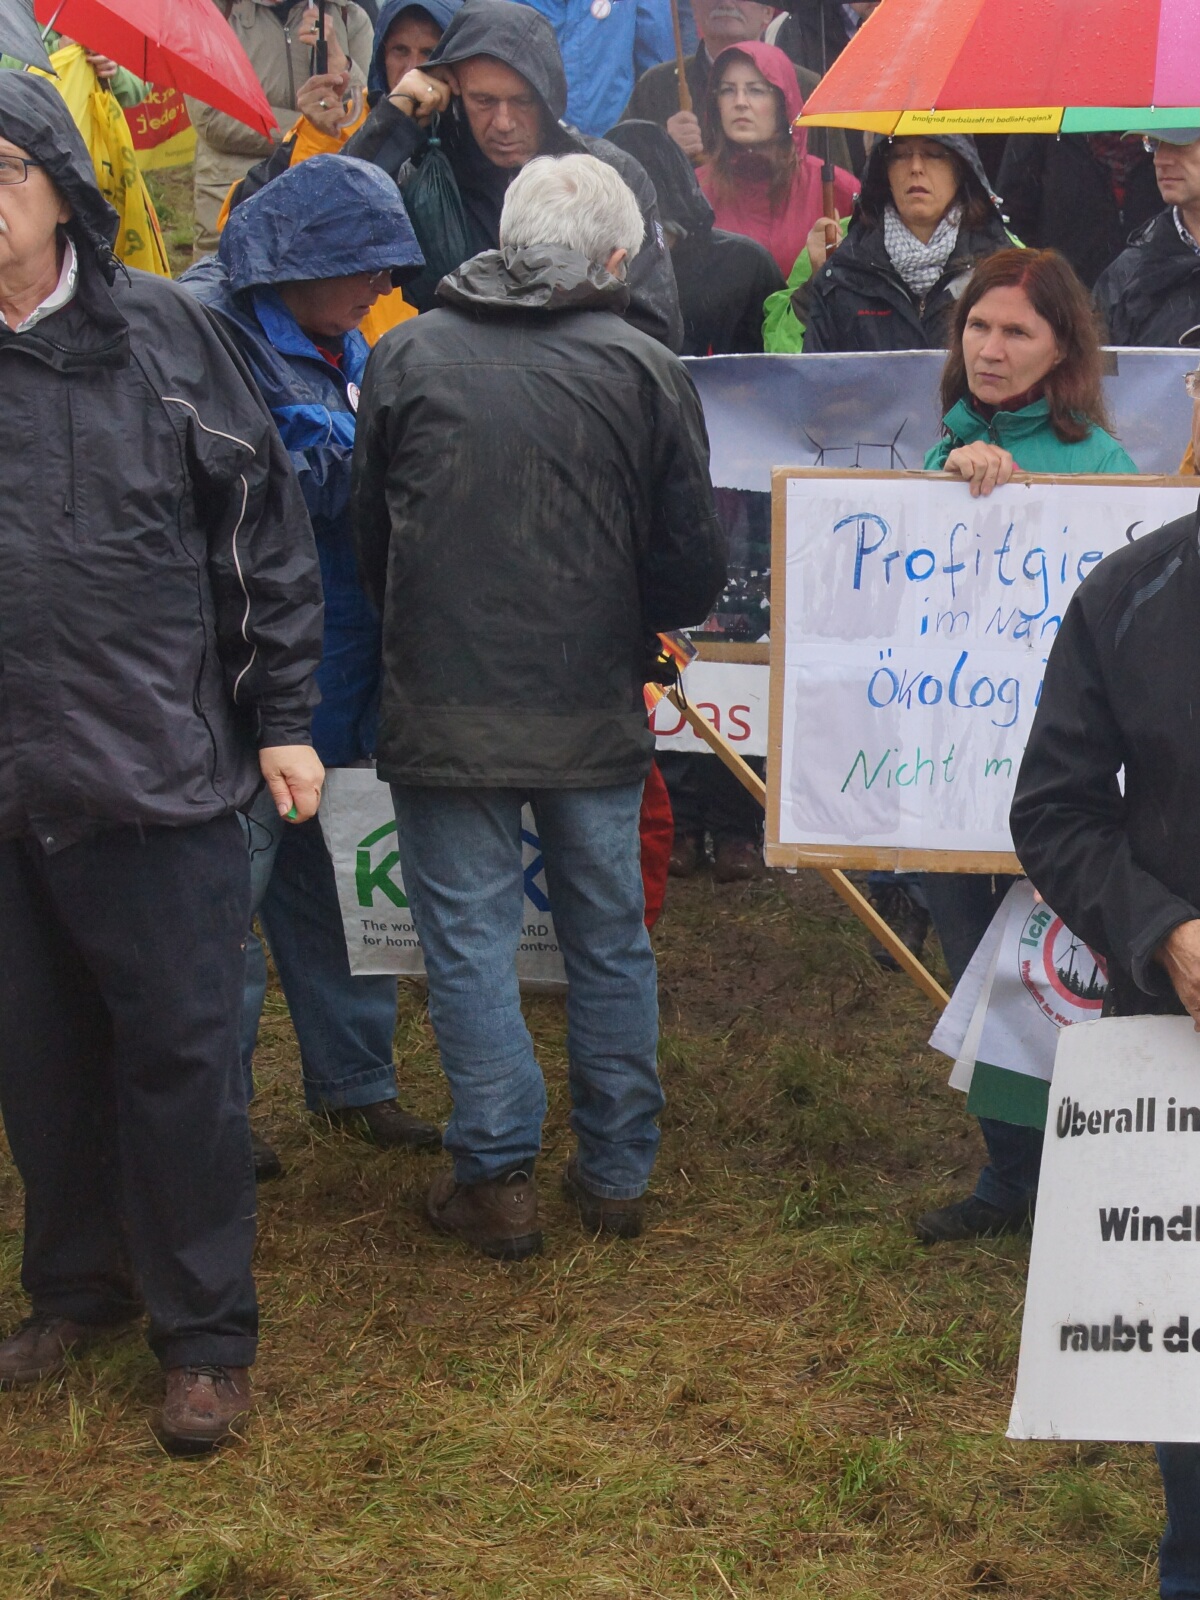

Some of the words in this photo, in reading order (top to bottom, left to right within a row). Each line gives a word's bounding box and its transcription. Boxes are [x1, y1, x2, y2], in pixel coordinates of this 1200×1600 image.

[833, 512, 1104, 620] Profitgie
[920, 597, 970, 636] im
[840, 743, 956, 793] Nicht
[361, 919, 387, 931] The
[391, 922, 416, 932] wor
[363, 934, 382, 946] for
[517, 942, 558, 953] ontro
[1020, 910, 1052, 948] Ich
[1056, 1097, 1156, 1139] Überall
[1059, 1315, 1153, 1353] raubt
